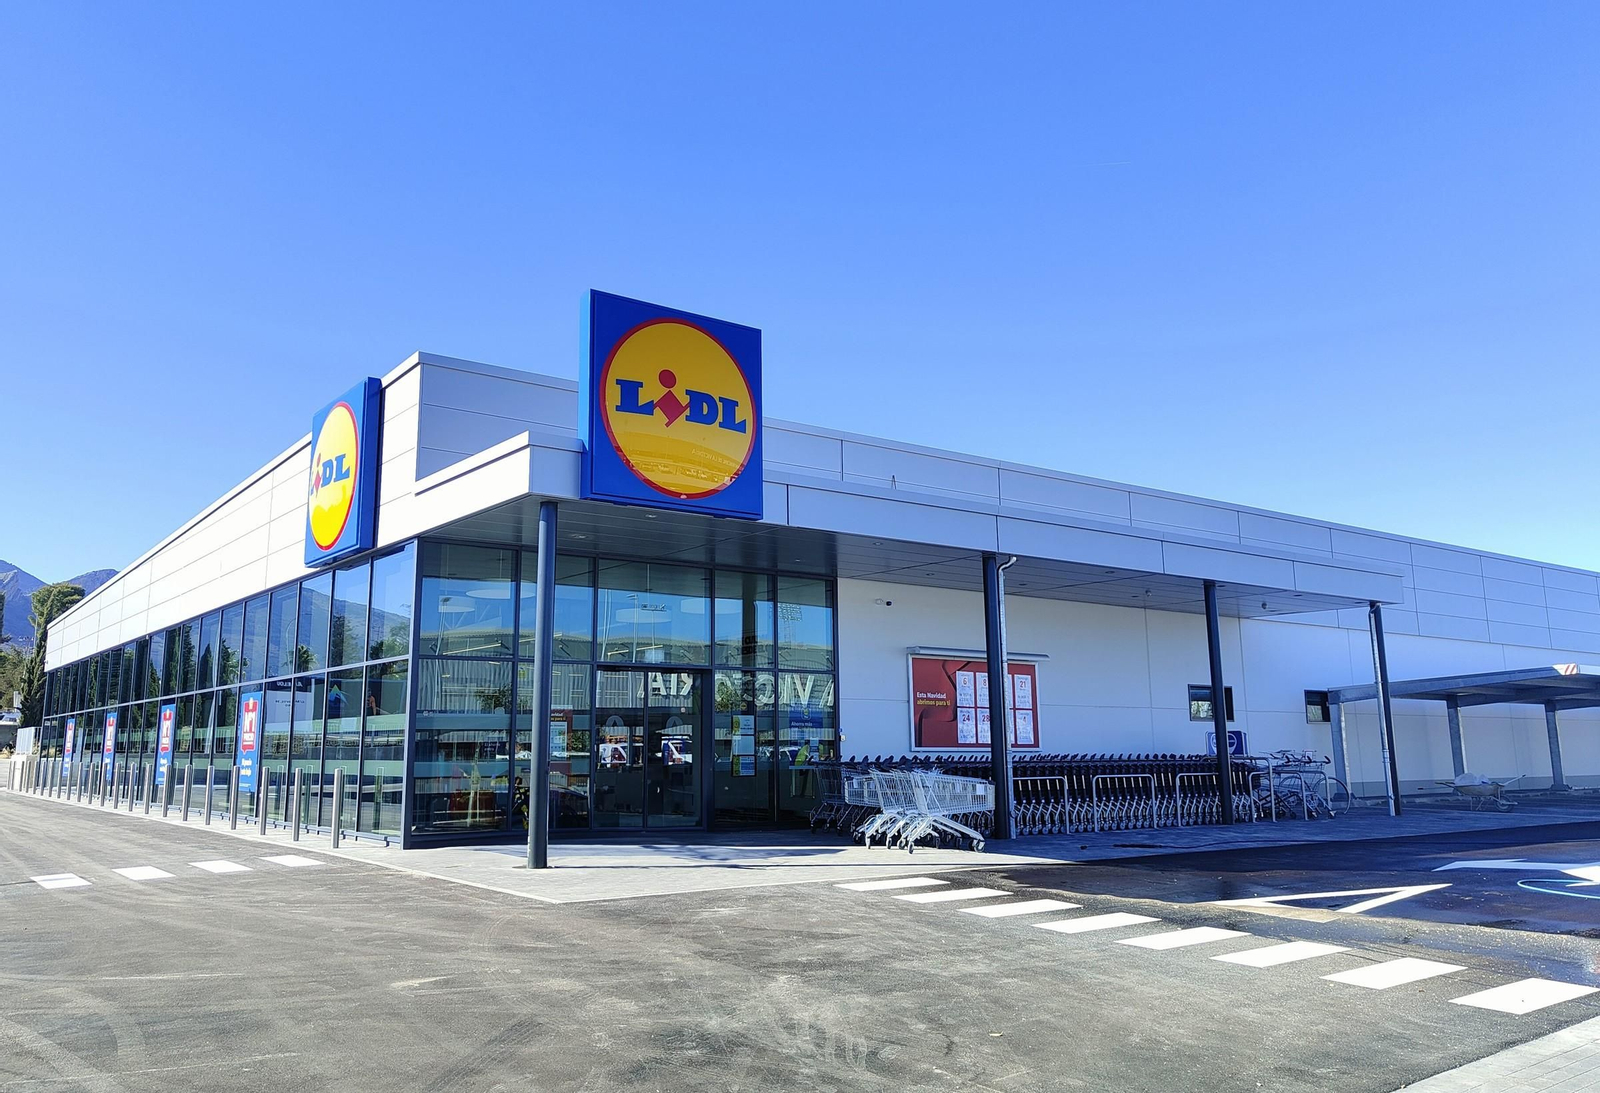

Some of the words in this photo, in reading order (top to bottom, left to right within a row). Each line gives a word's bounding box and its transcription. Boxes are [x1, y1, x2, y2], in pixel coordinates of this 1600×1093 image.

[311, 453, 350, 498] IDL
[962, 714, 971, 722] 24
[981, 714, 990, 722] 28
